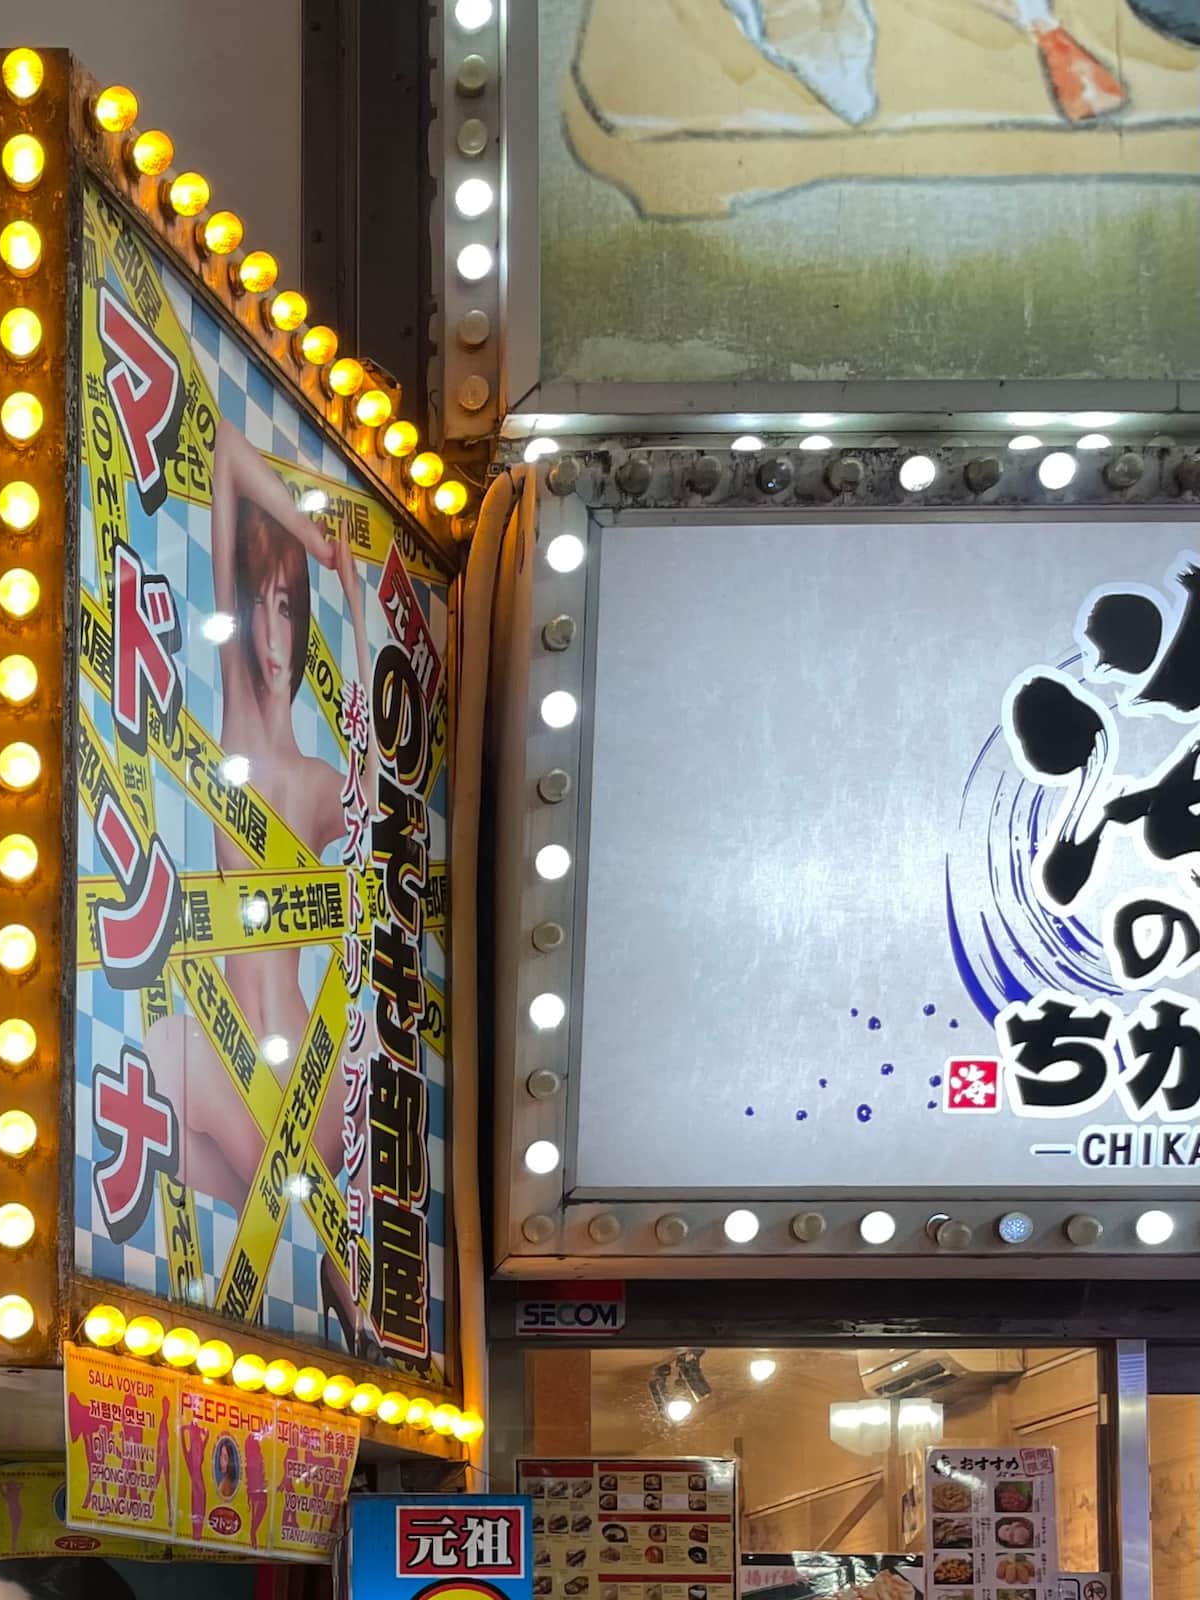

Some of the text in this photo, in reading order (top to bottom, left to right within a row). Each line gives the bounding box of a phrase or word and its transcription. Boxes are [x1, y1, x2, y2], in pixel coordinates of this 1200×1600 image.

[95, 284, 182, 1230] マドンナ
[342, 679, 369, 1302] 素人ストリップショー
[370, 642, 428, 1358] のぞき部屋
[260, 1016, 335, 1223] 元祖のぞき部屋
[523, 1303, 617, 1328] SECOM
[88, 1369, 154, 1398] SALA VOYEUR
[88, 1400, 156, 1429] 저렴한 엿보기
[181, 1393, 272, 1434] PEEP SHOW
[123, 1469, 156, 1491] VOYEUR
[959, 1456, 1020, 1471] おすすめ
[91, 1494, 124, 1518] RUANG
[406, 1517, 514, 1570] 元祖
